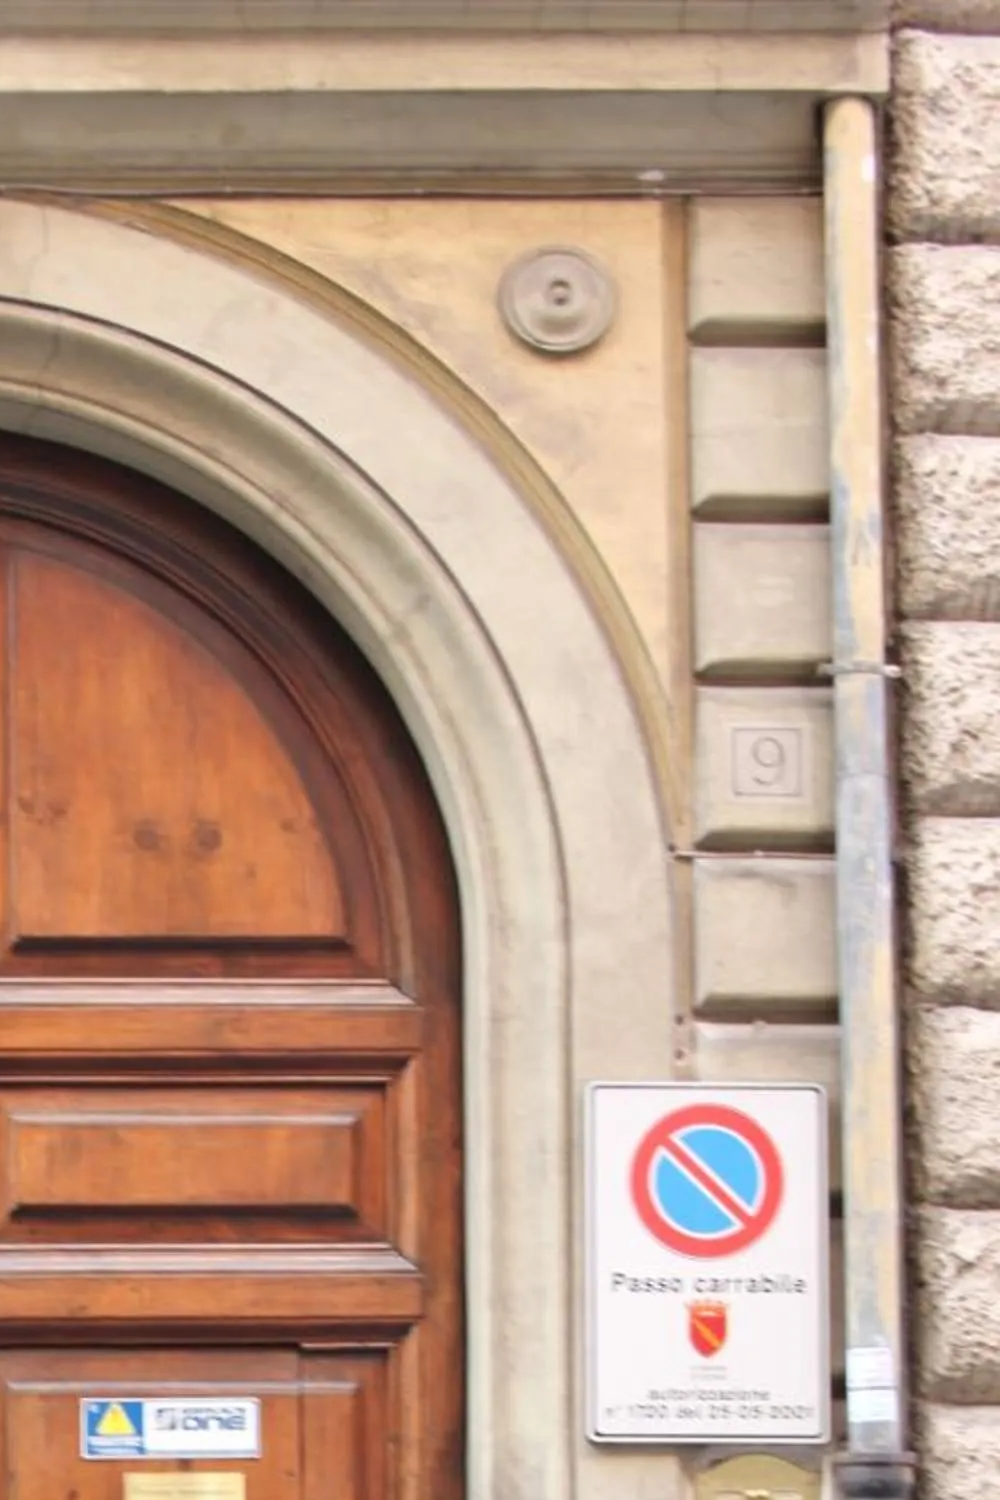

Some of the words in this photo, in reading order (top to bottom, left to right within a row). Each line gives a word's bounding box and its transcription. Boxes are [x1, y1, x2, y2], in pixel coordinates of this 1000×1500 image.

[751, 735, 786, 786] 9
[611, 1272, 682, 1293] Passo
[694, 1272, 808, 1294] carrabile
